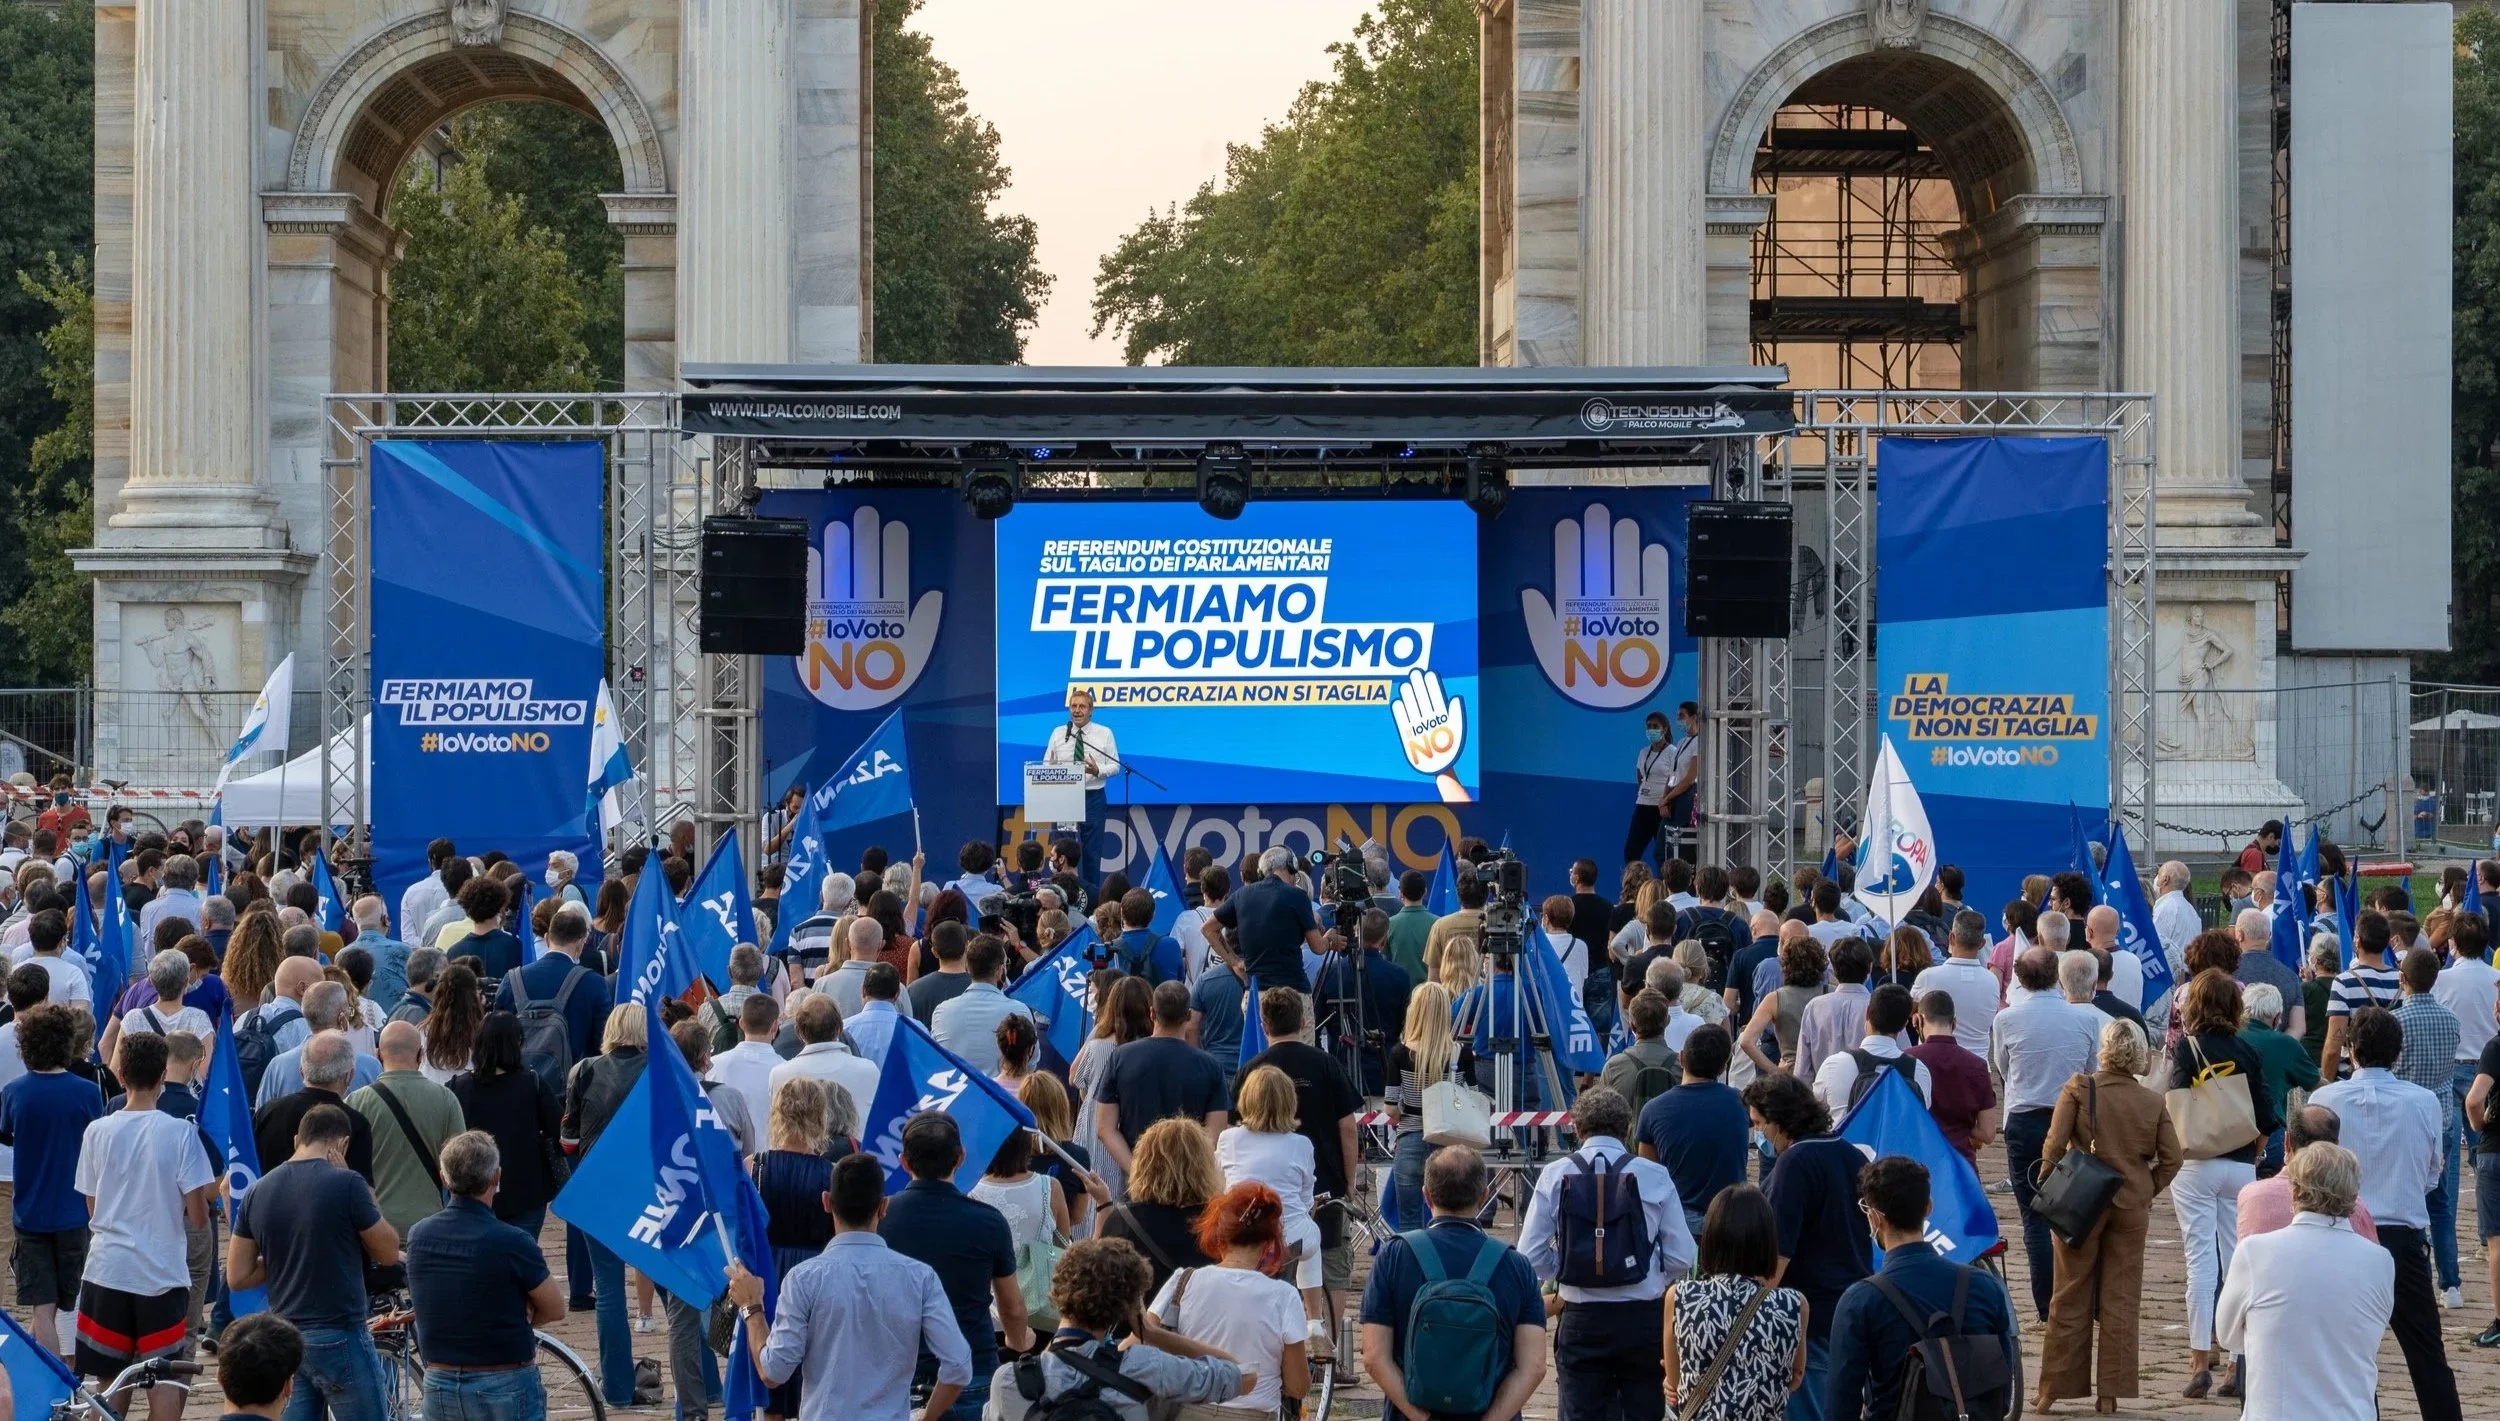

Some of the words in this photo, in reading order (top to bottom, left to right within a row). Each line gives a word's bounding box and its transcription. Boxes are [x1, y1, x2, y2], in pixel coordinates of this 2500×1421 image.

[709, 402, 901, 419] WWW.ILPALCOMOBILE.COM
[1609, 405, 1713, 418] TECNOSOUND
[1628, 420, 1657, 428] PALCO
[1658, 420, 1692, 428] MOBILE
[1043, 539, 1171, 556] REFERENDUM
[1173, 538, 1332, 555] COSTITUZIONALE
[1039, 557, 1077, 573] SUL
[1079, 556, 1145, 573] TAGLIO
[1149, 556, 1181, 572] DEI
[1183, 555, 1330, 572] PARLAMENTARI
[1039, 583, 1317, 625] FERMIAMO
[809, 619, 905, 639] #IoVoto
[1564, 616, 1660, 636] #IoVoto
[1081, 631, 1123, 669] IL
[1131, 627, 1423, 669] POPULISMO
[809, 640, 906, 690] NO
[1565, 638, 1660, 687] NO
[385, 681, 527, 701] FERMIAMO
[1101, 685, 1240, 703] DEMOCRAZIA
[1242, 685, 1289, 702] NON
[1292, 685, 1312, 701] SI
[1315, 684, 1387, 701] TAGLIA
[1909, 677, 1942, 695] LA
[406, 703, 428, 722] IL
[431, 701, 583, 722] POPULISMO
[1894, 697, 2066, 716] DEMOCRAZIA
[1406, 714, 1448, 739] IoVoto
[1915, 718, 1971, 737] NON
[1975, 718, 1998, 737] SI
[2002, 717, 2090, 736] TAGLIA
[420, 732, 550, 753] #IoVotoNO
[1409, 726, 1454, 765] NO
[1930, 745, 2059, 766] #IoVotoNO
[1001, 804, 1462, 873] #oVotoNO
